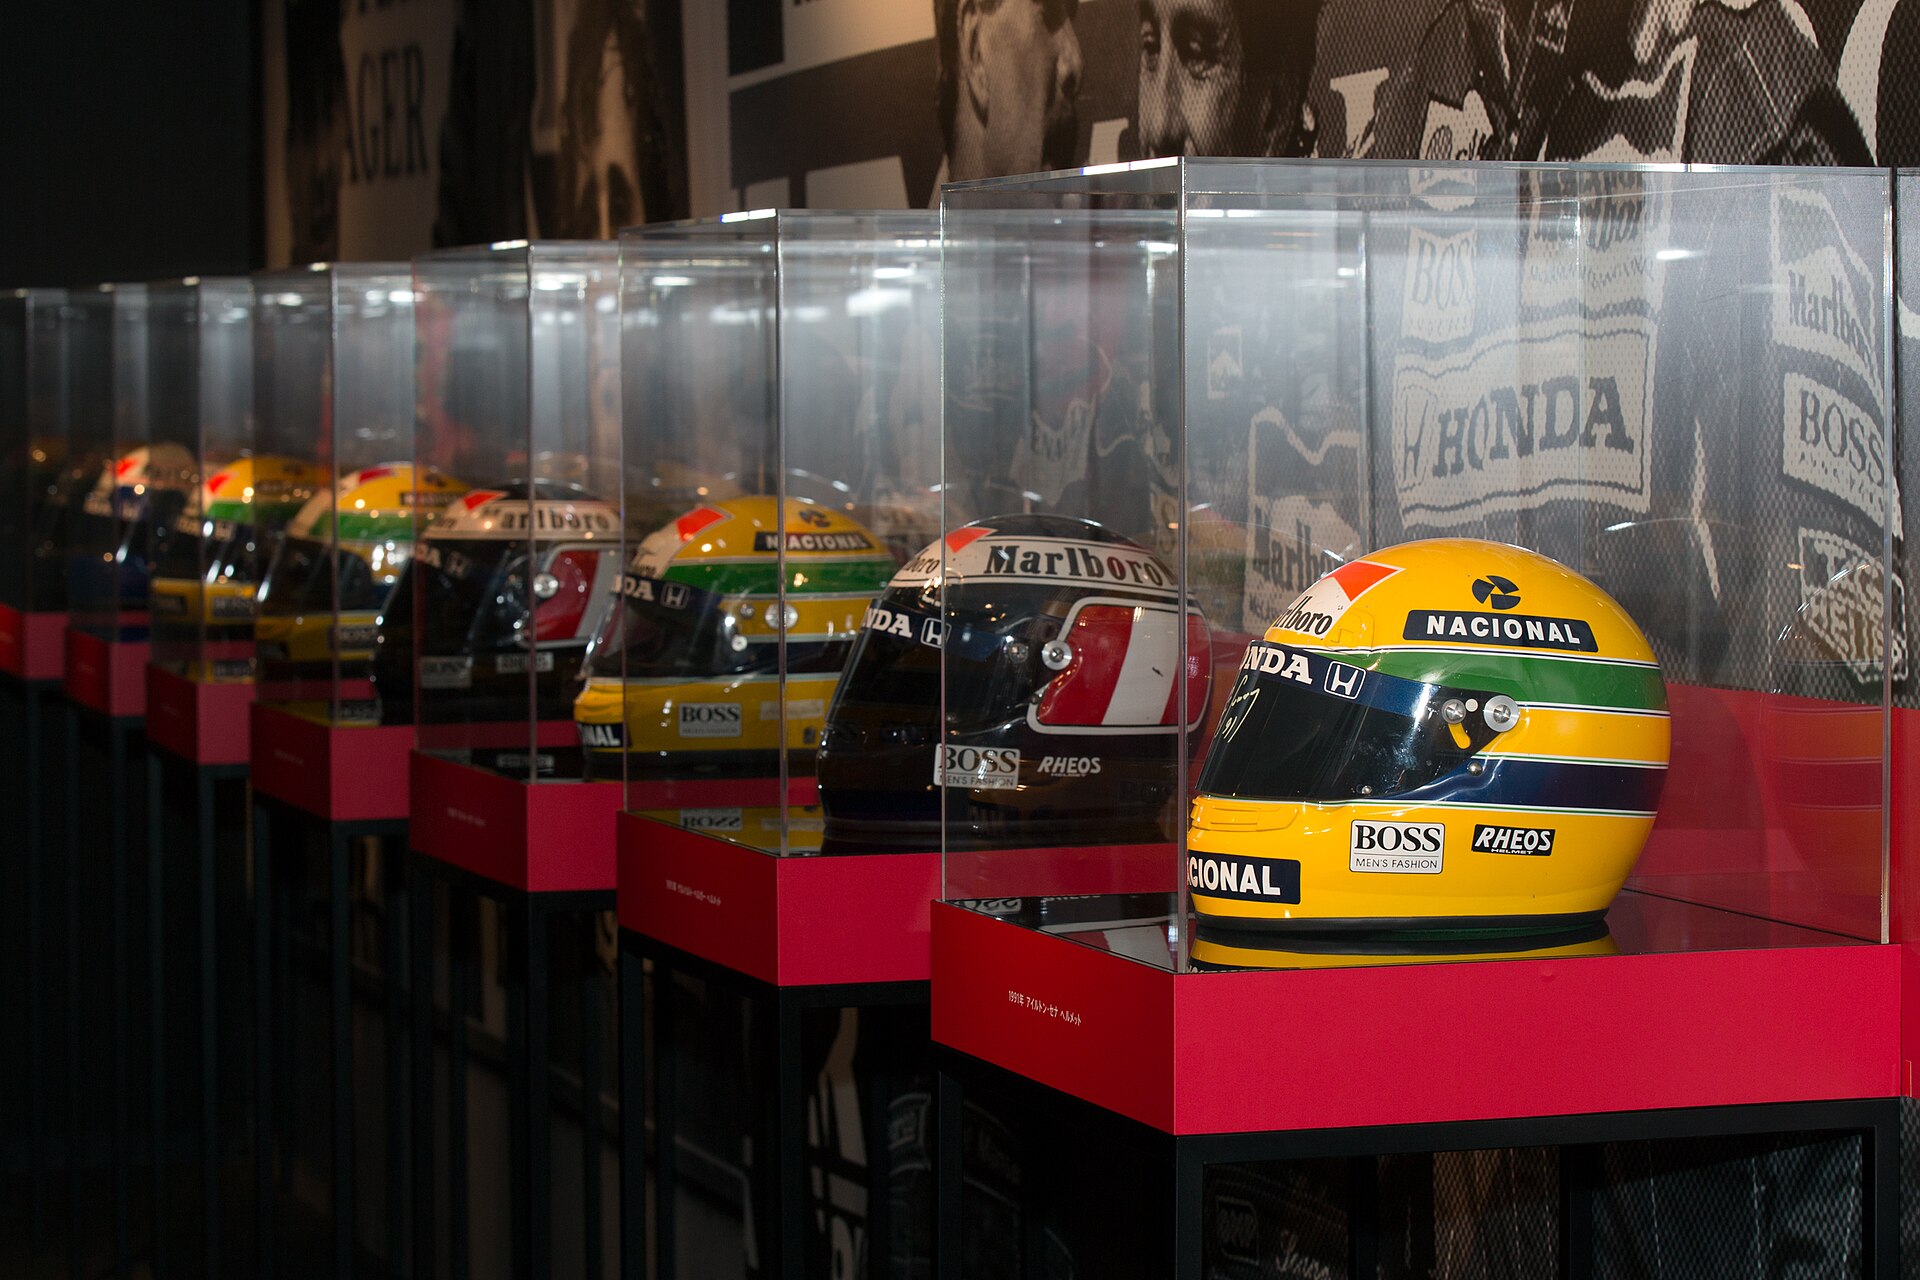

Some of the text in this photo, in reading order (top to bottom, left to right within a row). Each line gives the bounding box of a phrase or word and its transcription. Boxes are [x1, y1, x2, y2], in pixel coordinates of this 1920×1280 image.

[1431, 376, 1635, 478] HONDA
[1799, 390, 1884, 486] BOSS
[985, 546, 1163, 586] Marlboro
[1426, 615, 1581, 644] NACIONAL
[1240, 645, 1313, 685] NDA
[682, 707, 739, 722] BOSS
[1036, 756, 1102, 774] RHEOS
[1354, 824, 1441, 852] BOSS
[1474, 827, 1551, 851] RHEOS
[1355, 857, 1438, 869] MEN'S FASHION
